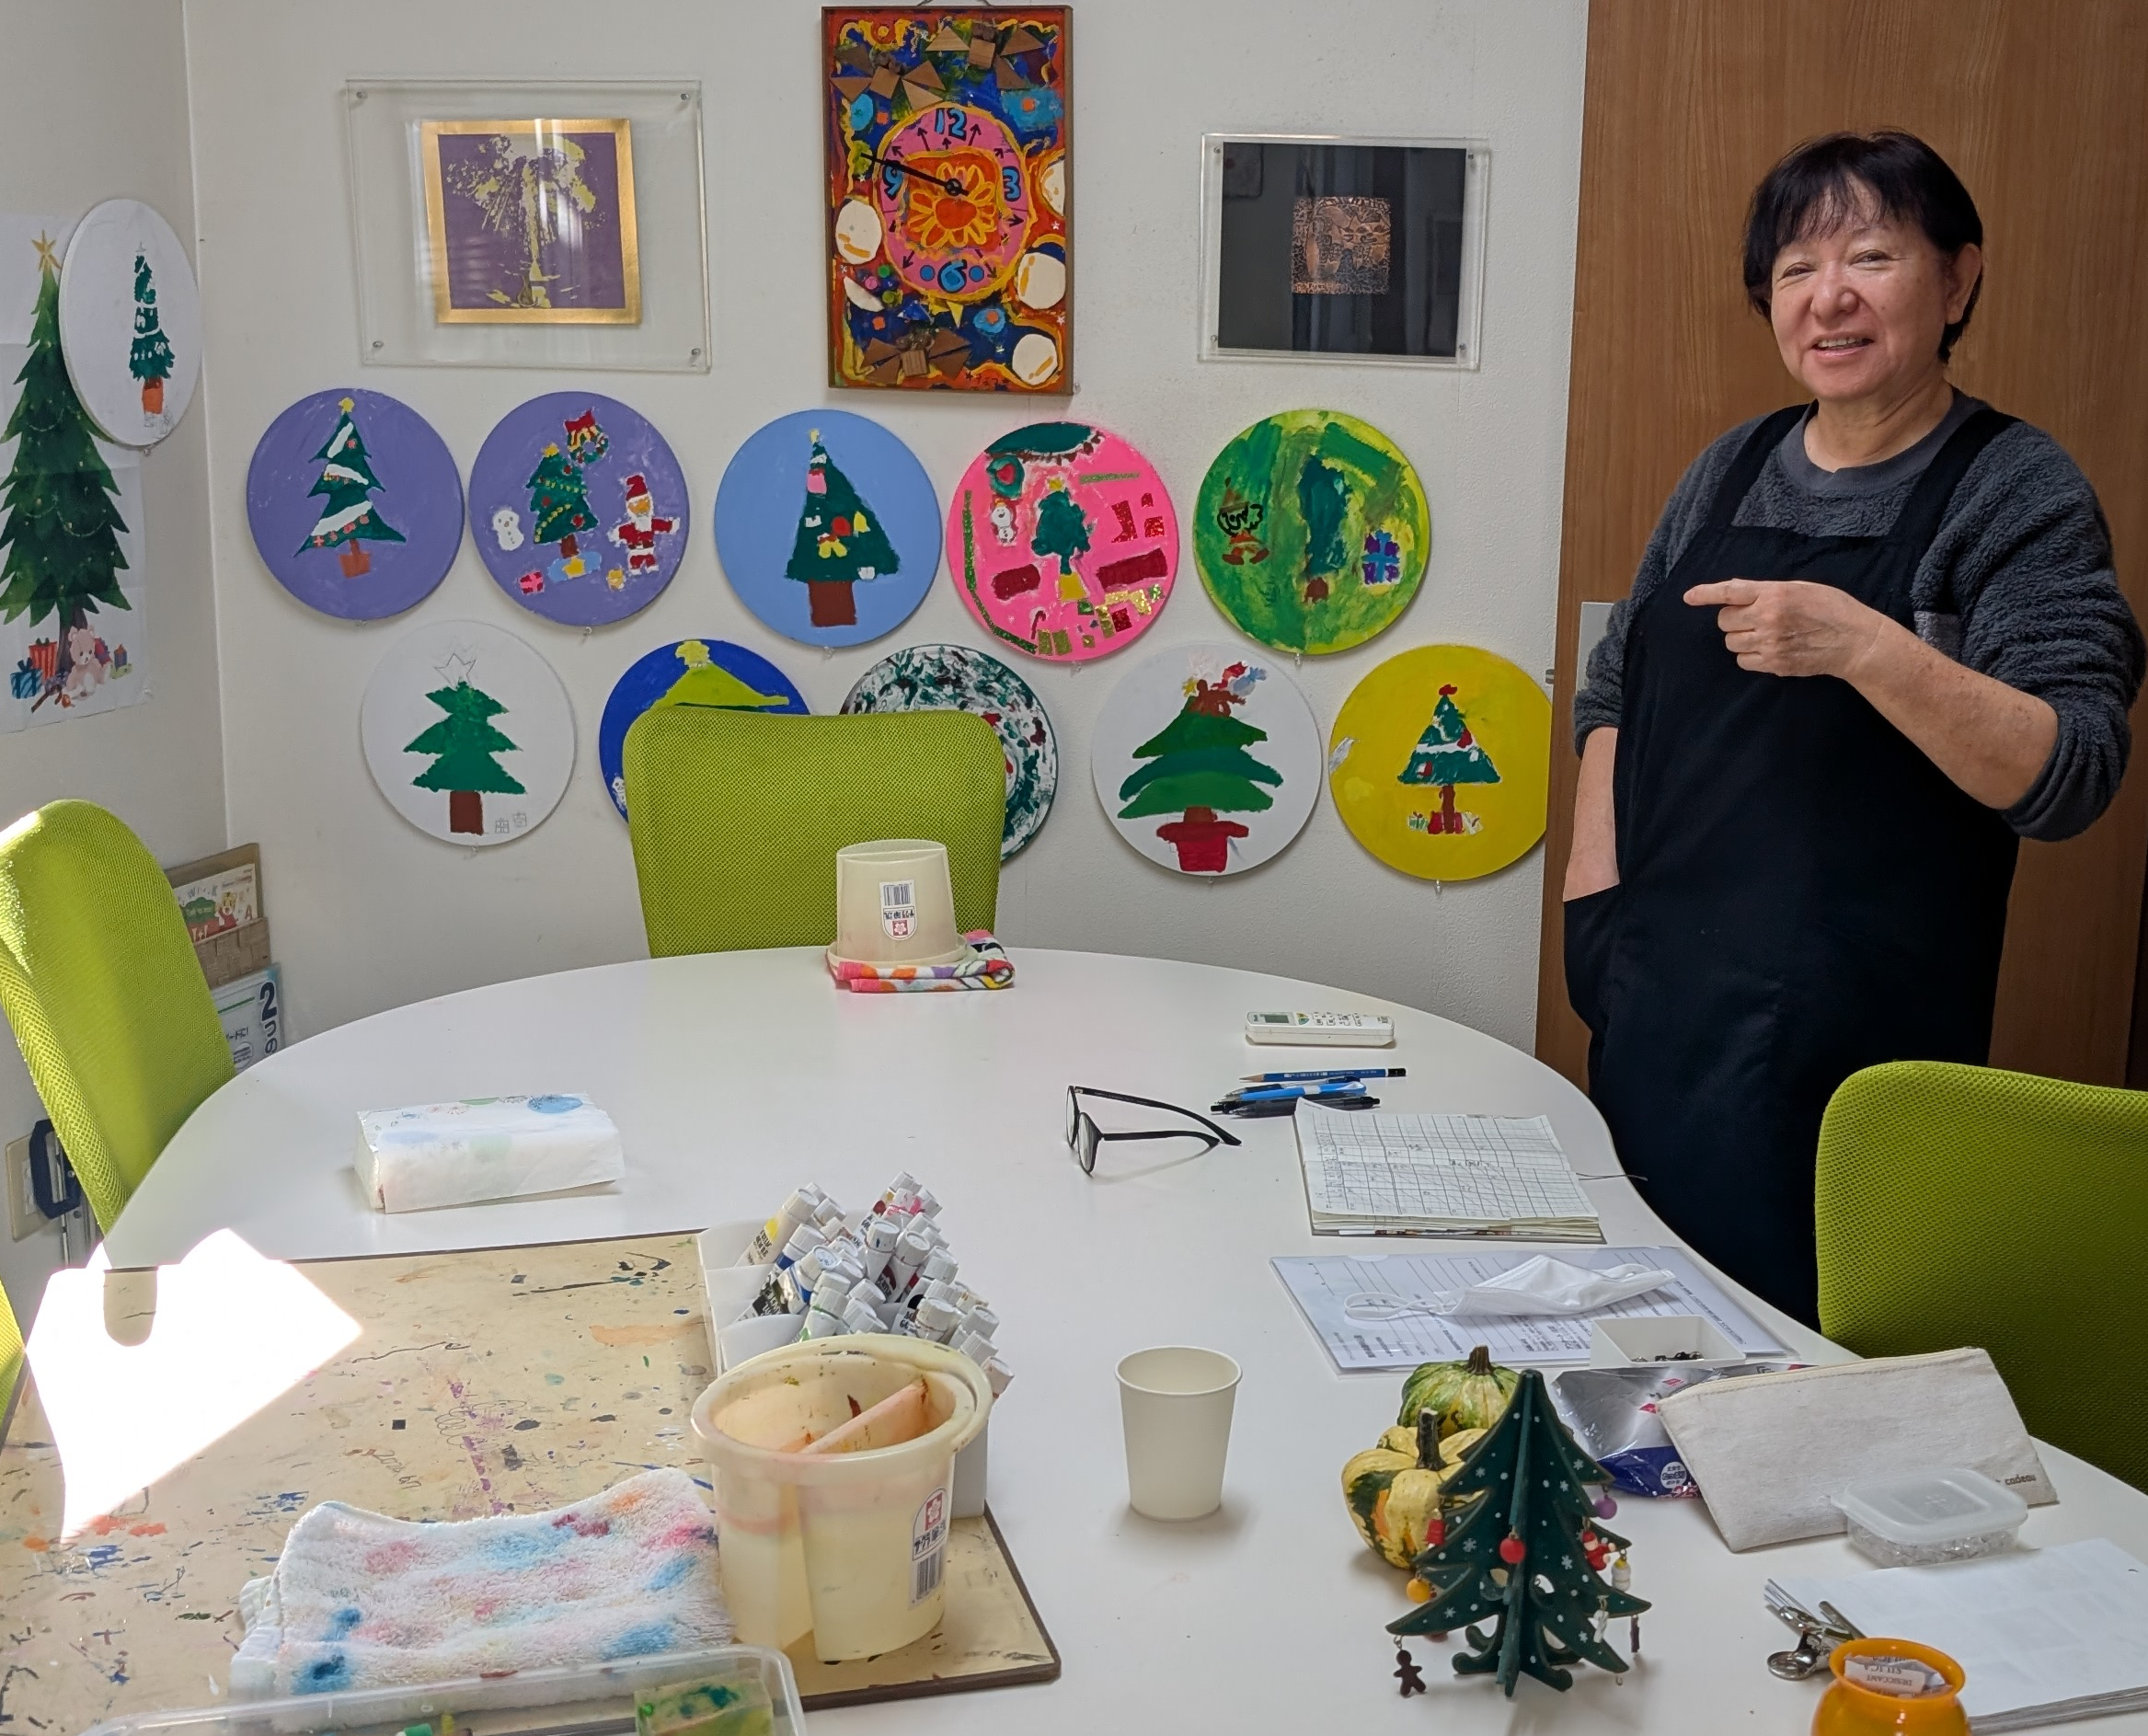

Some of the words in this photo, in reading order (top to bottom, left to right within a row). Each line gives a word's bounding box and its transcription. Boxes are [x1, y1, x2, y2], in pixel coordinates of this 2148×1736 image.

[935, 109, 967, 141] 12
[882, 159, 904, 196] 9
[1002, 167, 1021, 201] 3
[937, 260, 967, 293] 6
[2004, 1474, 2037, 1486] cadeau
[1864, 1664, 1902, 1674] SILICA
[1866, 1674, 1913, 1686] DESICCANT
